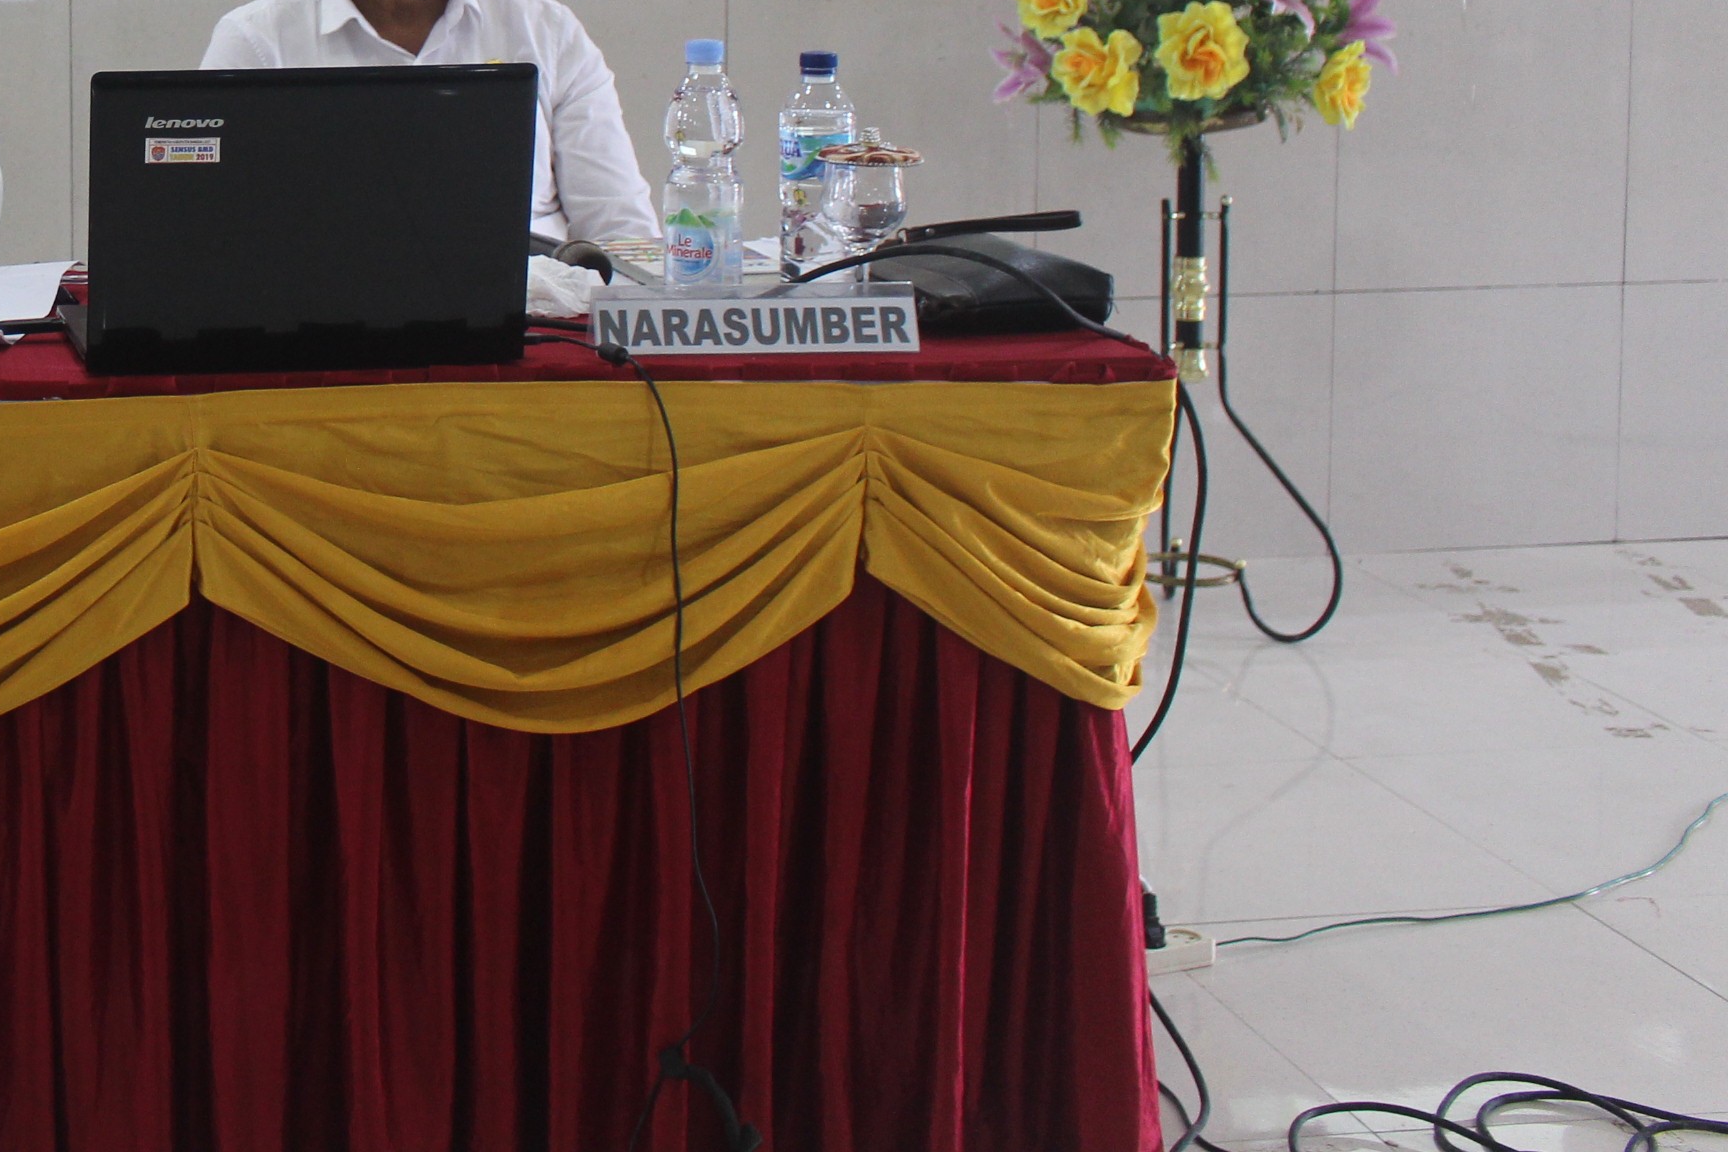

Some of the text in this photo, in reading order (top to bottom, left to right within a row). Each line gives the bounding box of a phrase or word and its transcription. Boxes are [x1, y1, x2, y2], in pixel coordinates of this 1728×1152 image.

[145, 116, 224, 128] lenovo
[780, 138, 803, 159] UA
[678, 233, 692, 247] Le
[667, 244, 713, 259] Minerale
[599, 306, 909, 348] NARASUMBER
